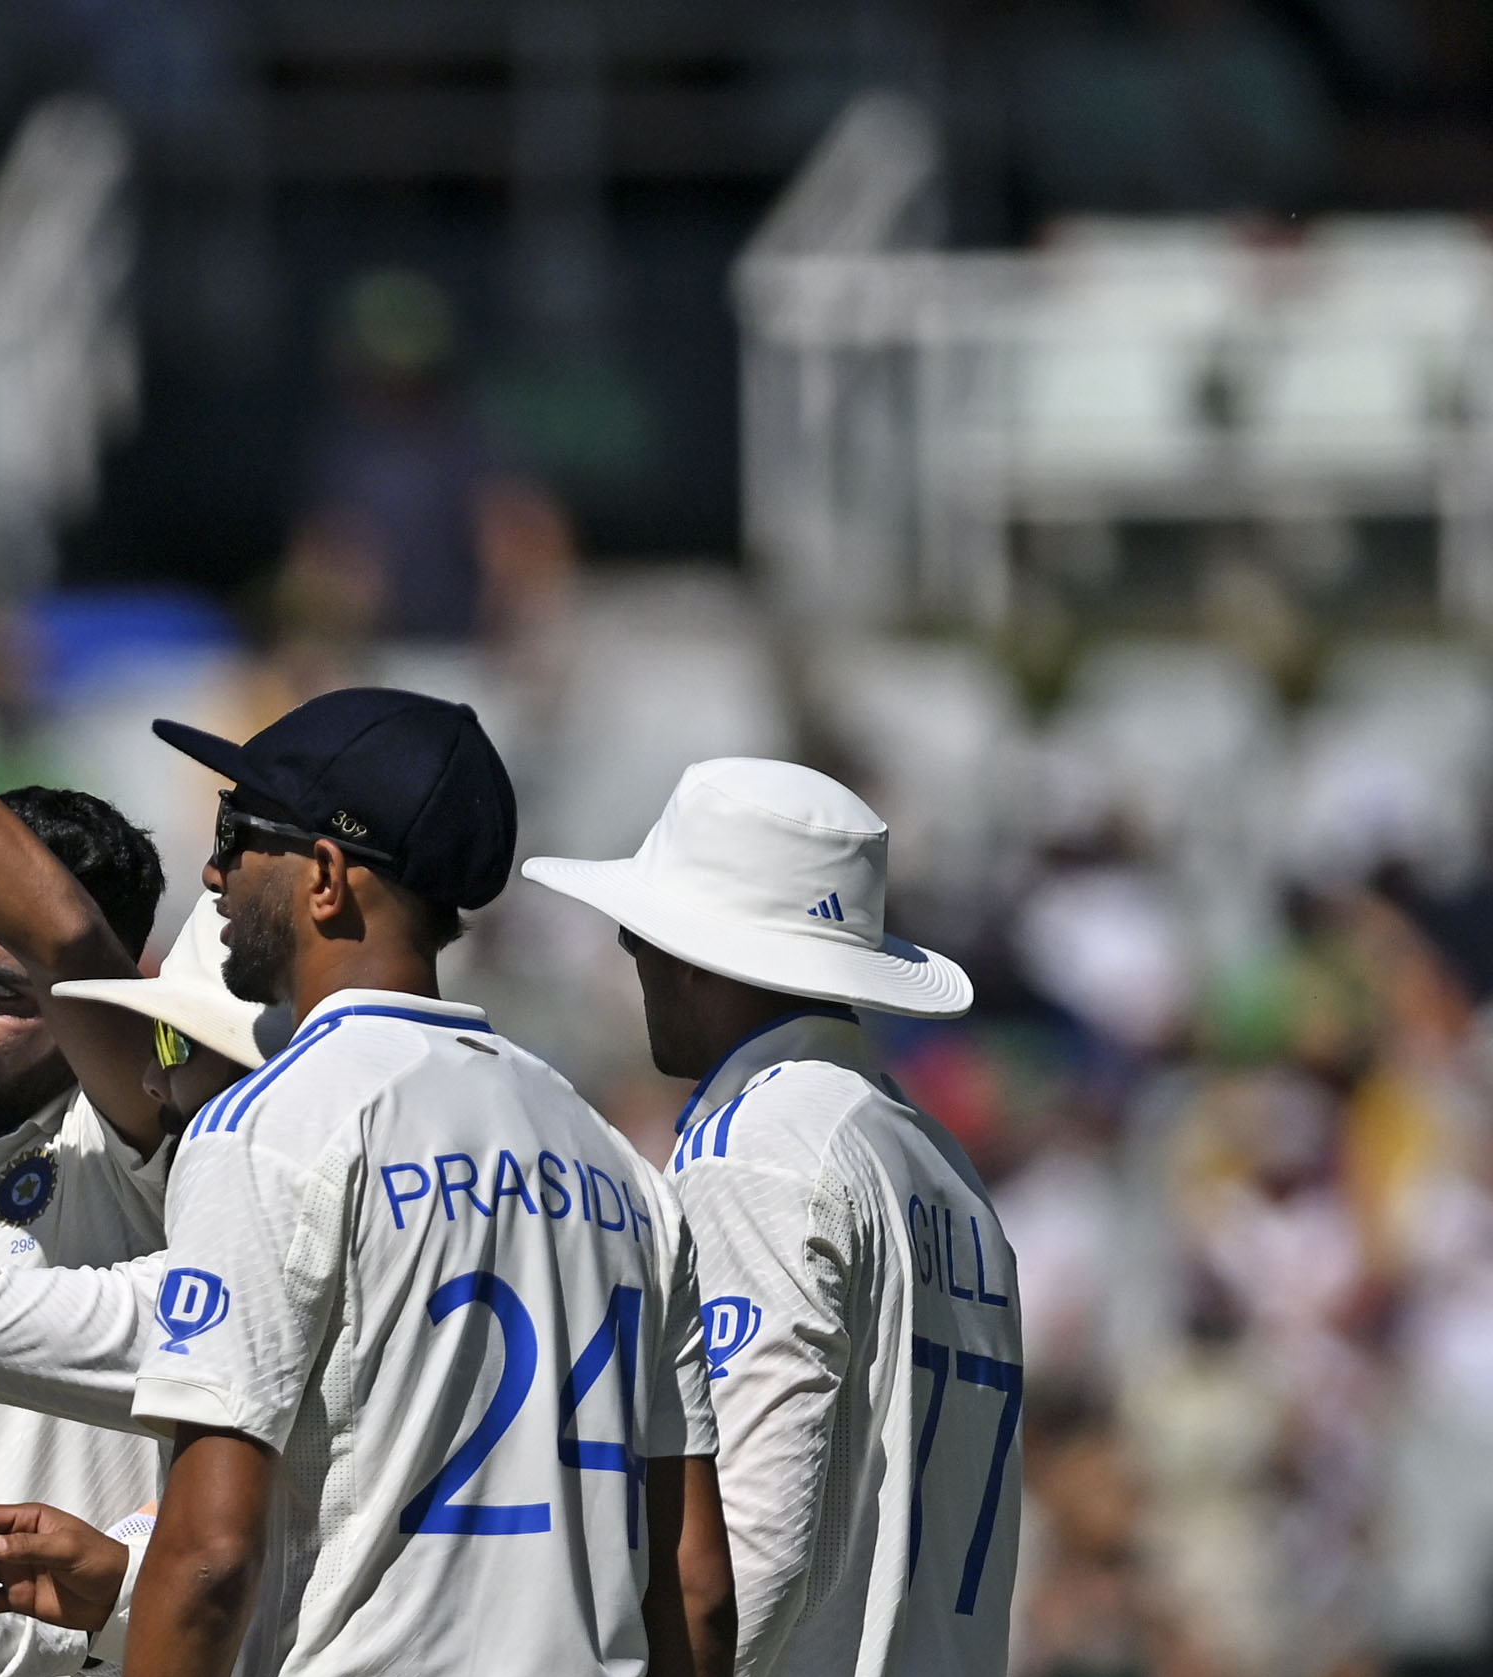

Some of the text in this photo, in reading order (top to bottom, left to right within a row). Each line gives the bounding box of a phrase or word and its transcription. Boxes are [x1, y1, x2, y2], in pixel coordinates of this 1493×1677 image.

[331, 809, 367, 838] 309
[10, 1237, 36, 1255] 298
[380, 1149, 654, 1243] PRASIDH
[909, 1194, 1009, 1308] GILL
[399, 1270, 647, 1550] 24
[909, 1335, 1024, 1617] 77
